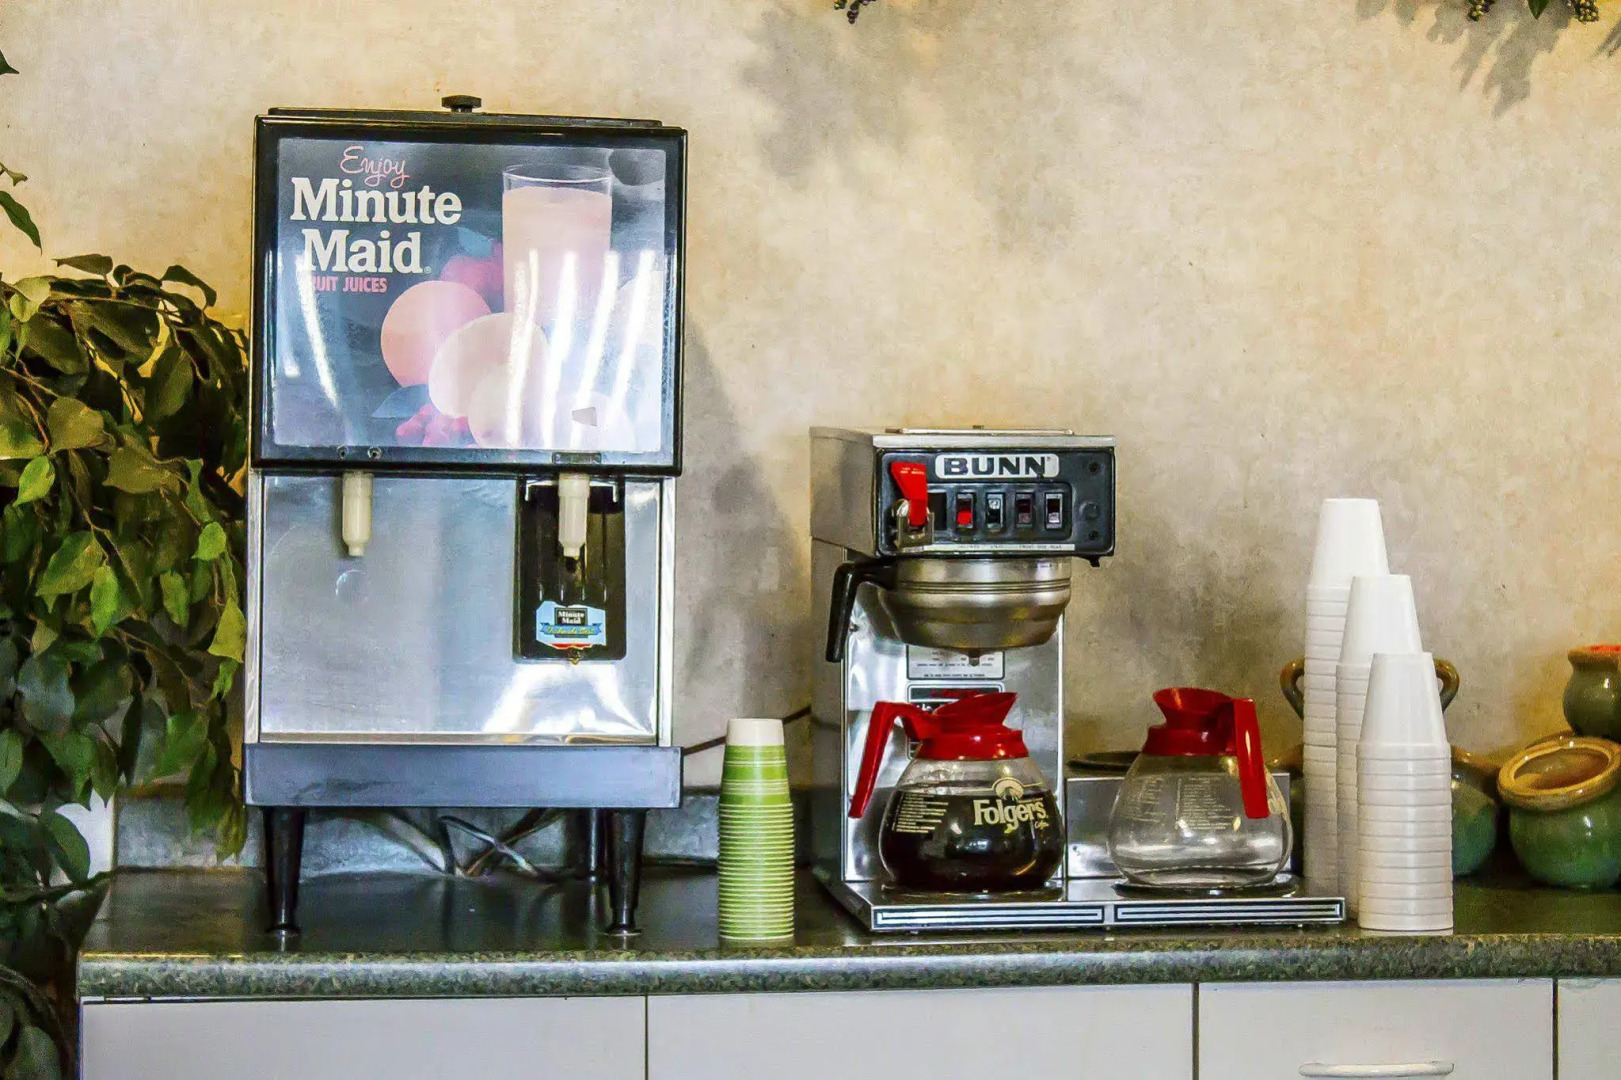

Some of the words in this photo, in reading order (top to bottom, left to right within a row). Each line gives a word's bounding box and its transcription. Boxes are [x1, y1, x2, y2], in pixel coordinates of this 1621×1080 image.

[340, 146, 410, 188] Enjoy
[290, 177, 462, 225] Minute
[302, 229, 424, 273] Maid
[311, 276, 339, 292] UIT
[343, 277, 388, 293] JUICES
[944, 457, 1046, 476] BUNN
[973, 799, 1046, 834] Folgers
